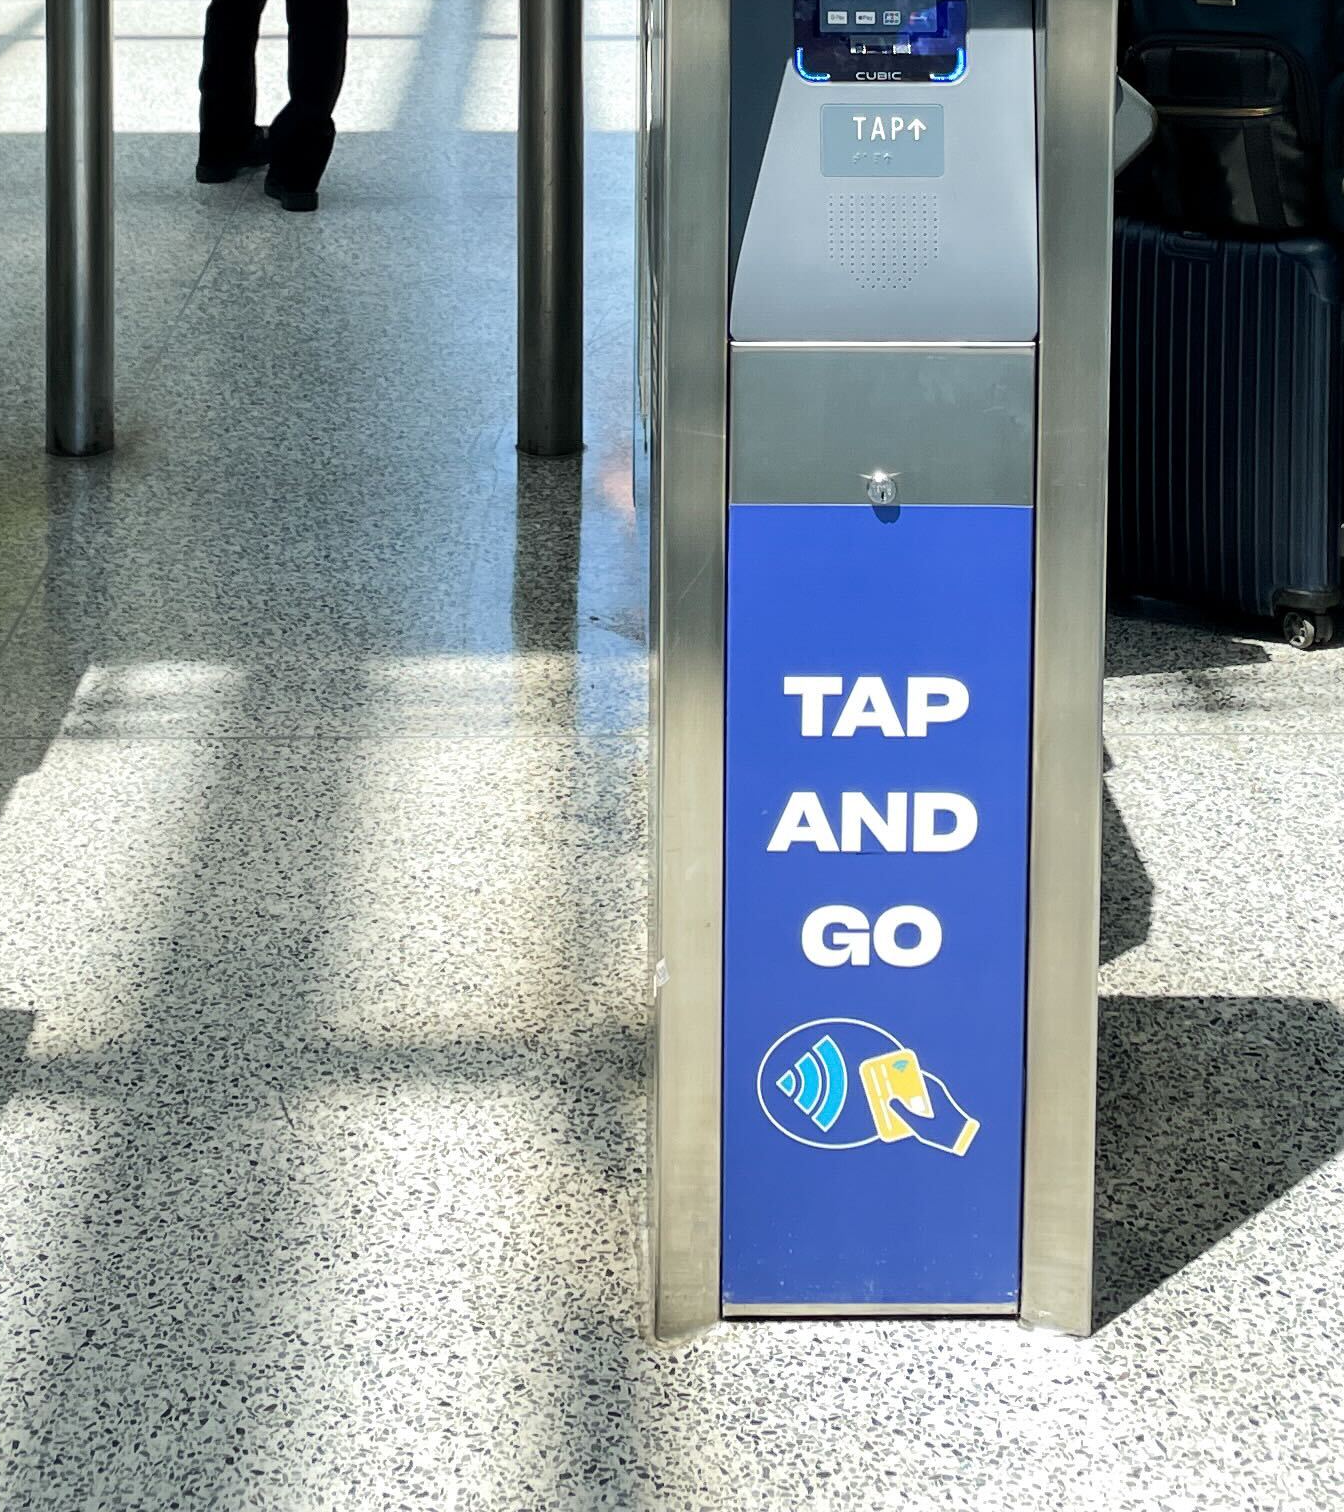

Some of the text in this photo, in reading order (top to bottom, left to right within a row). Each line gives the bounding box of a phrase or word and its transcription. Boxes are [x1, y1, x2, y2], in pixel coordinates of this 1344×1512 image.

[855, 71, 903, 81] CUBIC
[852, 116, 905, 141] TAP
[783, 676, 970, 737] TAP
[766, 791, 978, 853] AND
[800, 904, 943, 968] GO
